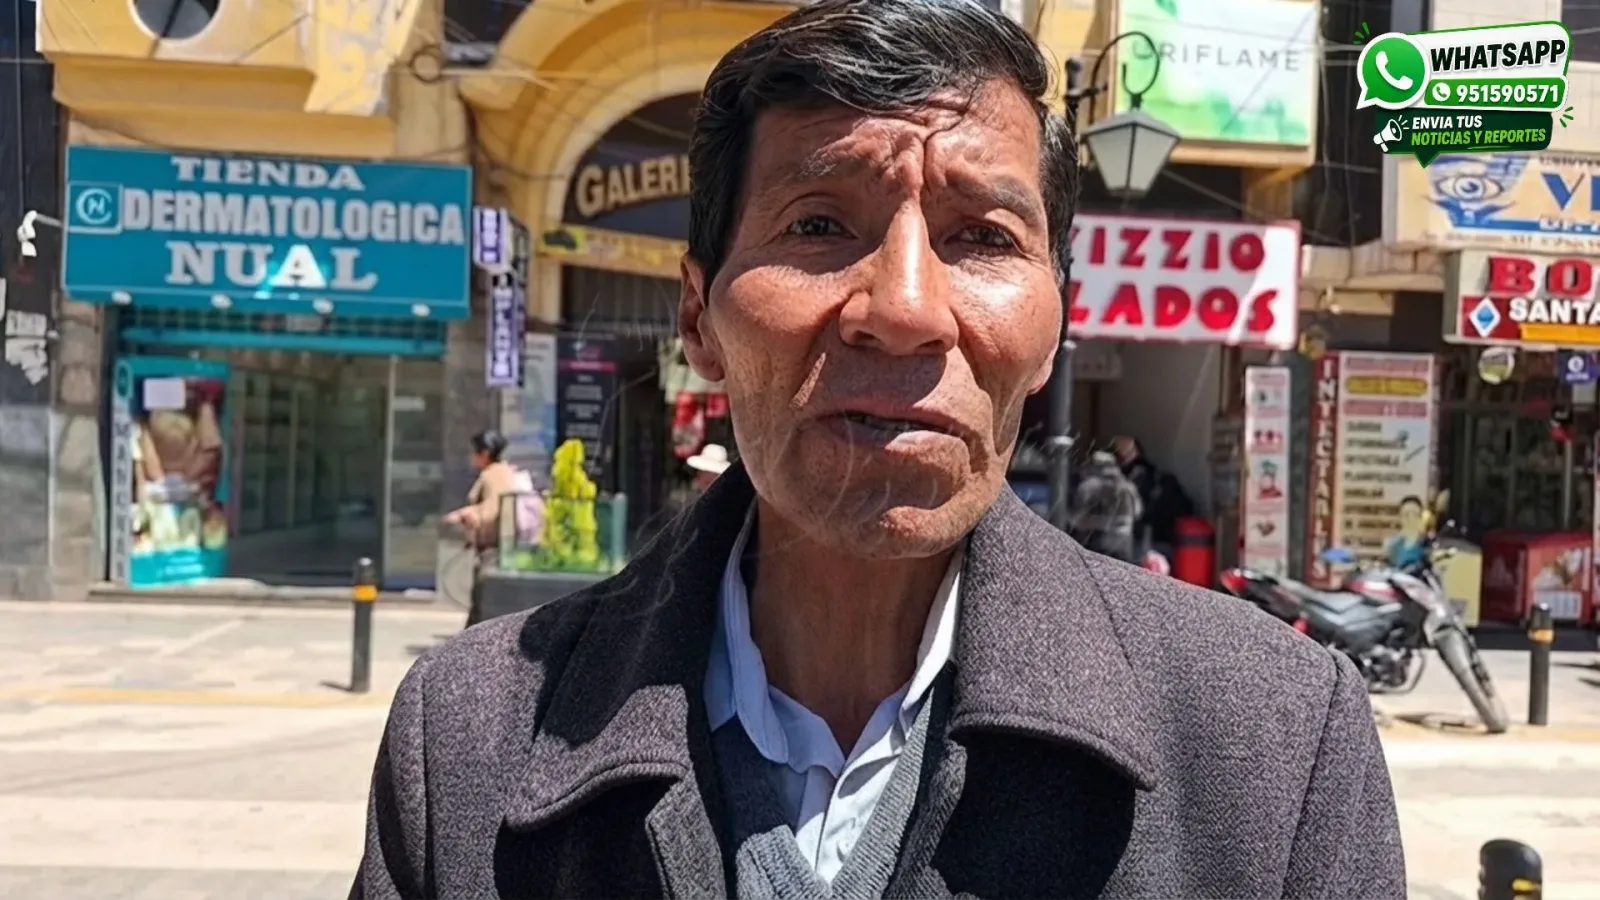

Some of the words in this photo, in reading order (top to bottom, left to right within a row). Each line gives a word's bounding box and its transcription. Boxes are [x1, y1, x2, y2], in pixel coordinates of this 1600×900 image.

[1132, 41, 1300, 71] ORIFLAME
[171, 156, 365, 190] TIENDA
[123, 187, 465, 245] DERMATOLOGICA
[164, 240, 378, 291] NUAL
